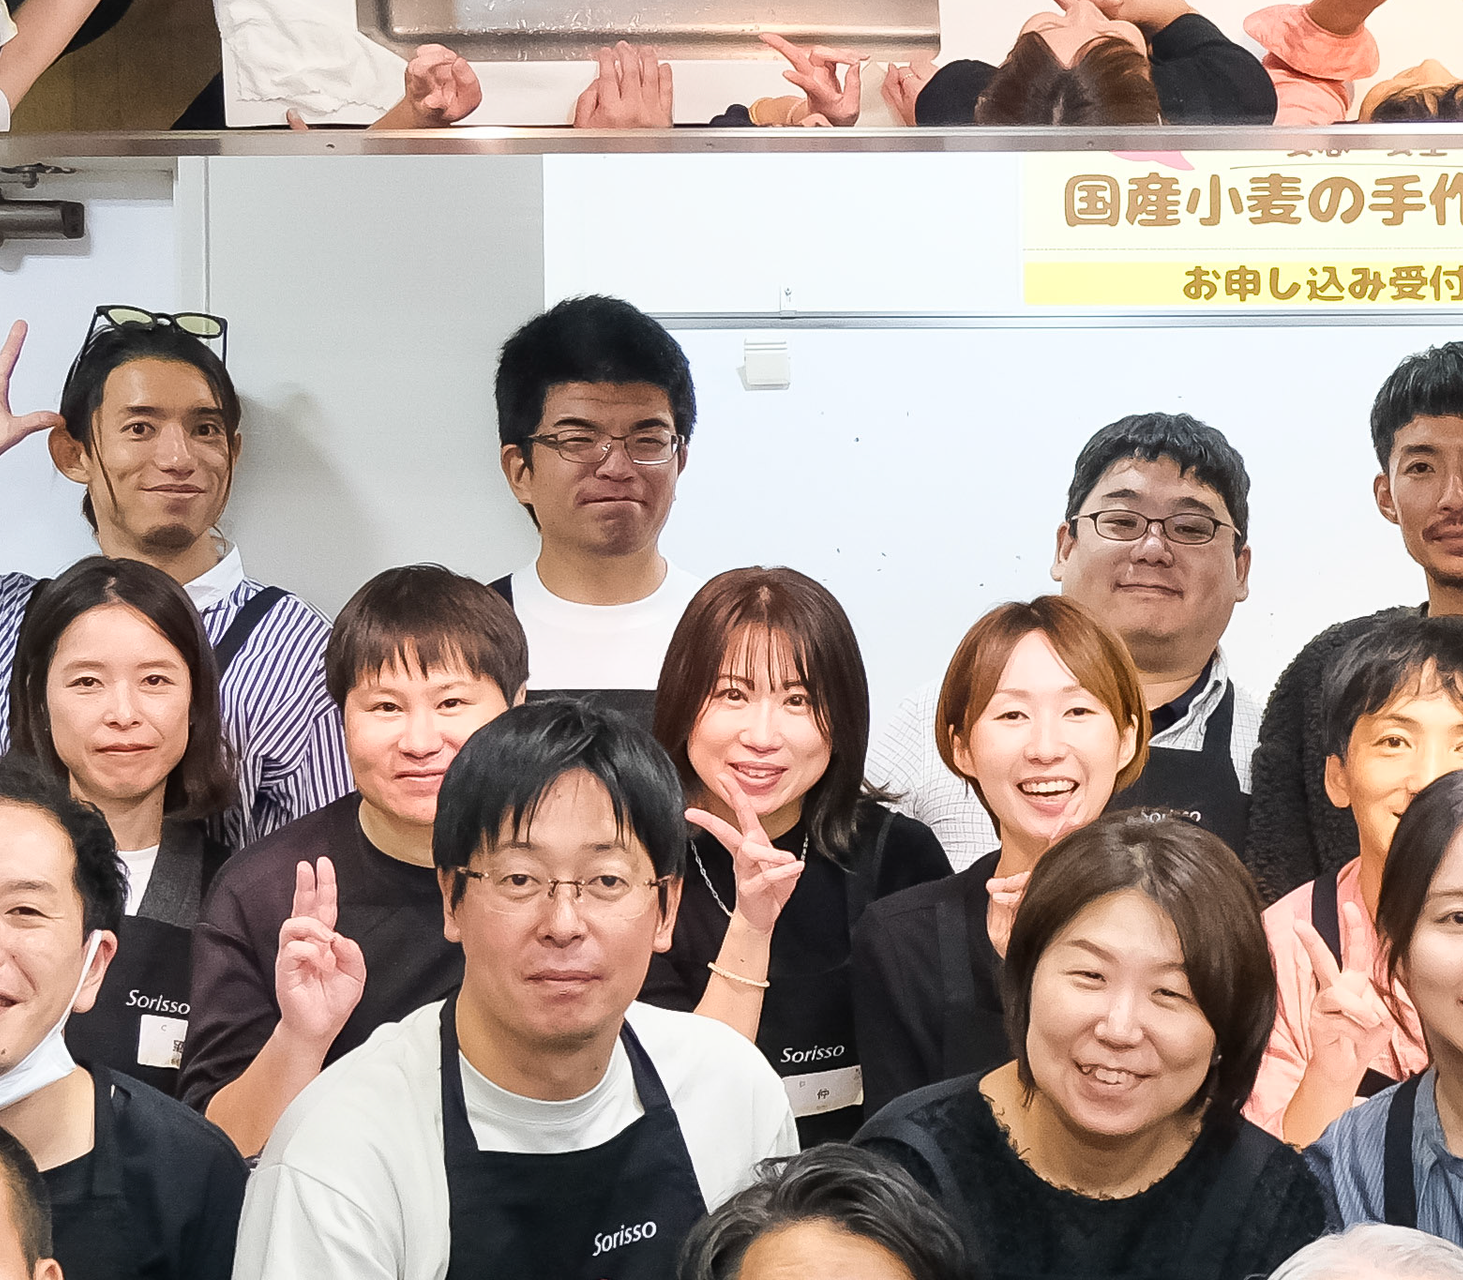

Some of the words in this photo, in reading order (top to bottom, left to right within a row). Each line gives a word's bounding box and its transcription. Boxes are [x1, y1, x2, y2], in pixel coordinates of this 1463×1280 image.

[126, 989, 191, 1015] Sorisso
[780, 1045, 845, 1063] Sorisso
[592, 1220, 657, 1257] Sorisso
